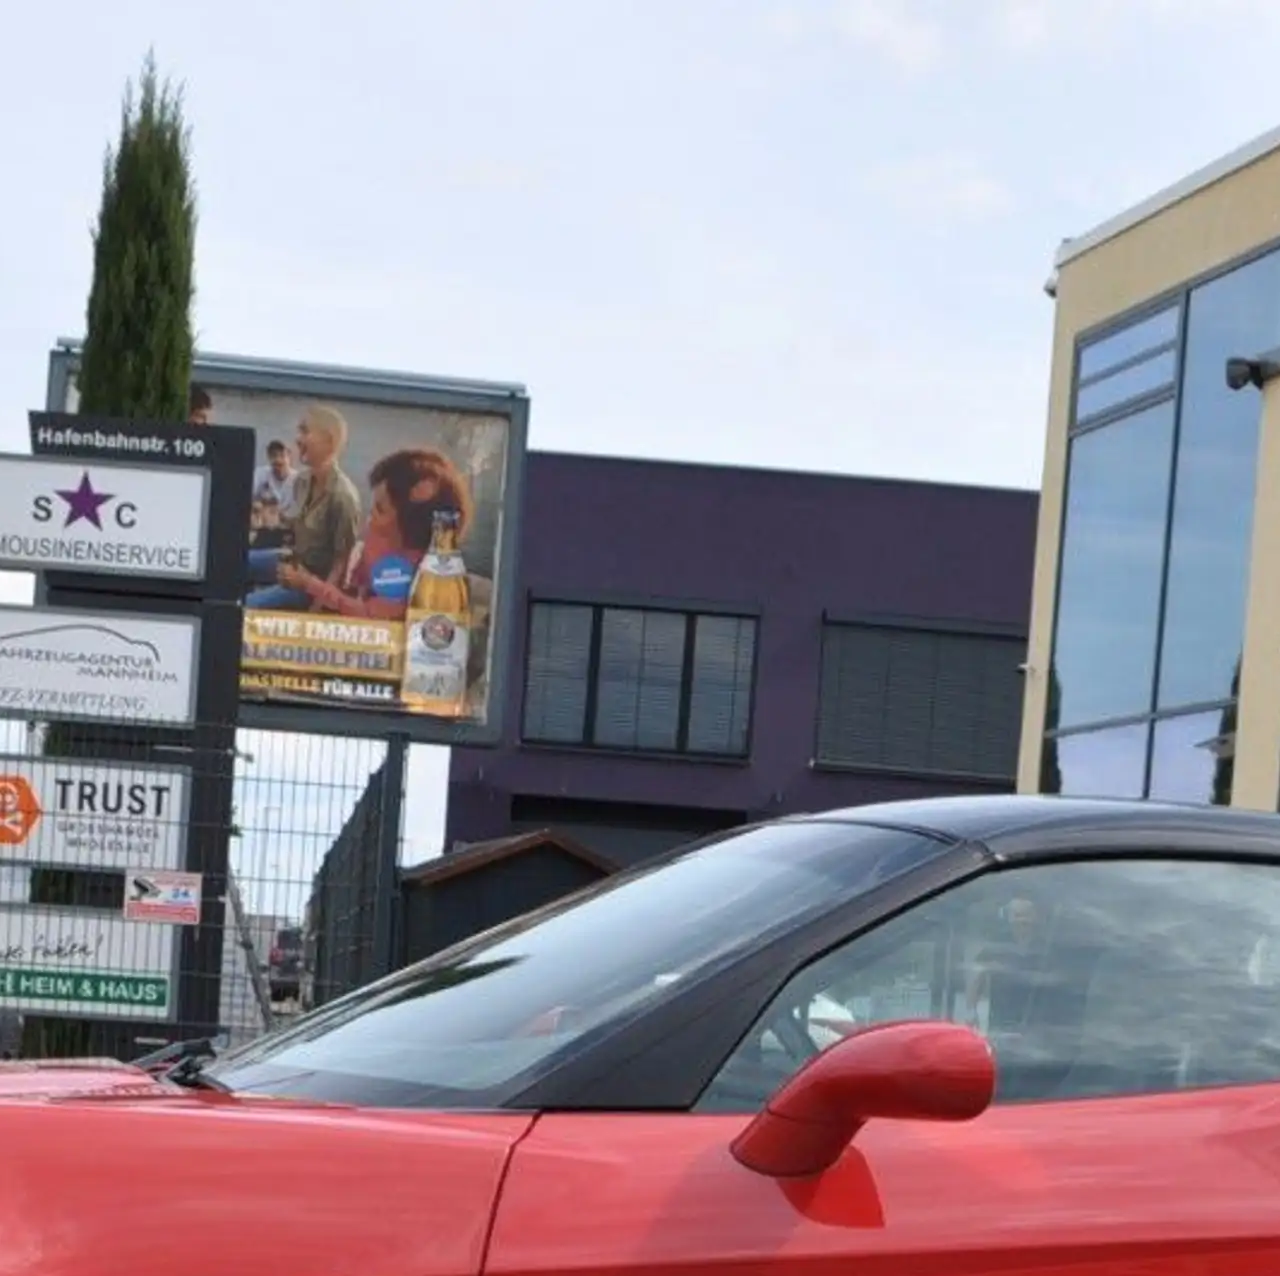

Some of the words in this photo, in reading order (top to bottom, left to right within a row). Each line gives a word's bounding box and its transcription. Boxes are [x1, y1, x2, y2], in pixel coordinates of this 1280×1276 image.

[38, 428, 169, 453] Hafenbahnstr.
[174, 439, 205, 456] 100
[32, 496, 52, 522] S
[115, 502, 137, 529] C
[323, 677, 353, 696] FÜR
[354, 683, 395, 700] ALLE
[55, 778, 170, 817] TRUST
[20, 975, 70, 996] HEIM
[78, 979, 95, 997] &
